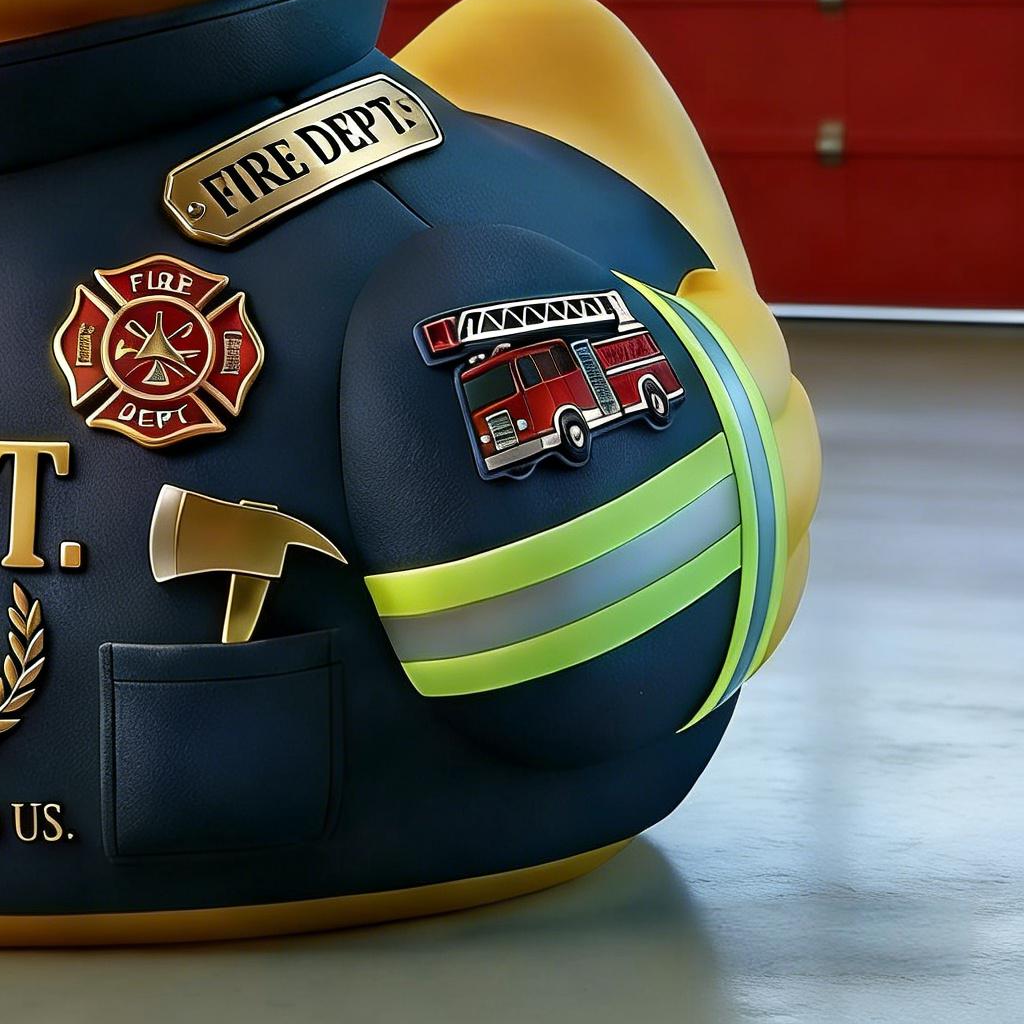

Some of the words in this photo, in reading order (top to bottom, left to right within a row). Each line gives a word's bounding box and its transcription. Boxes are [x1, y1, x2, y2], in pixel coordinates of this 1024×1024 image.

[200, 138, 310, 217] FIRE
[118, 402, 188, 428] DEPT
[11, 803, 74, 843] US.
